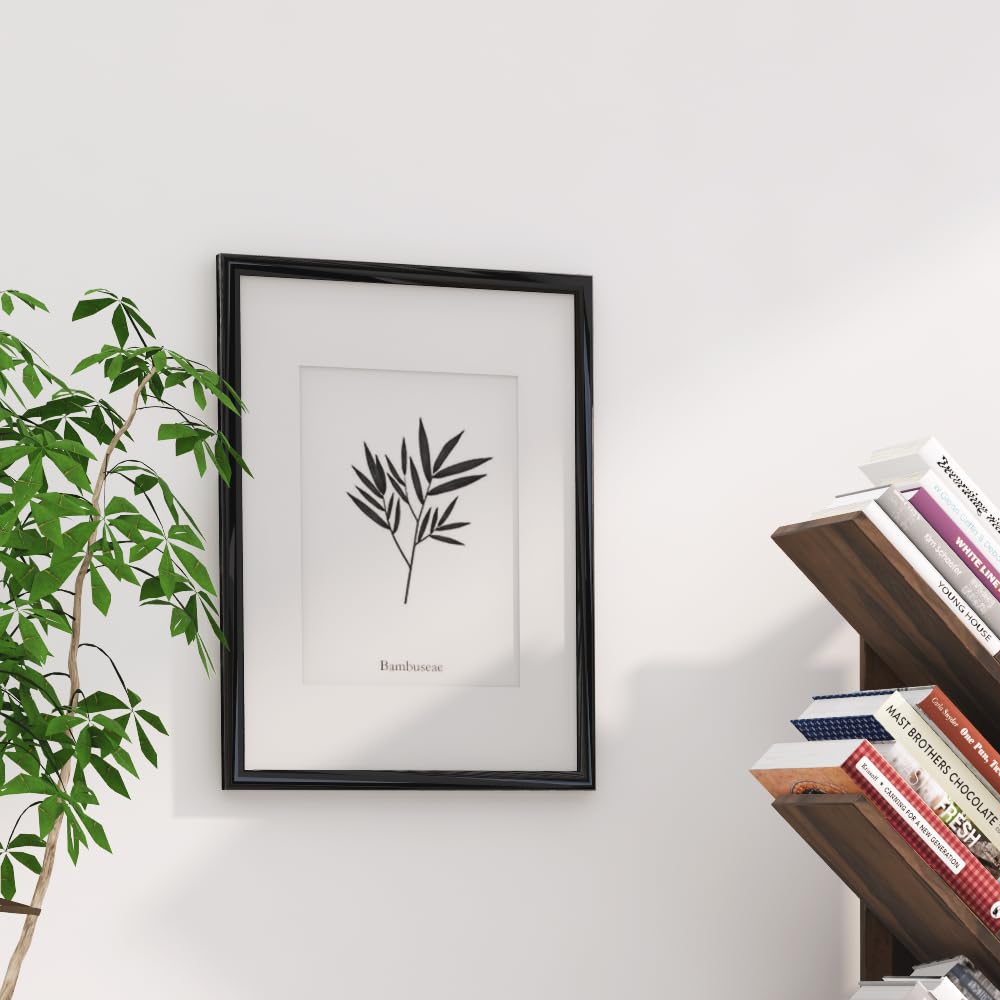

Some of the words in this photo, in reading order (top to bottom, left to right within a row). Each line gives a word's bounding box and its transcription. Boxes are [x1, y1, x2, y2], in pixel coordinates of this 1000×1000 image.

[955, 536, 984, 568] WHITE
[980, 563, 1000, 590] LINE
[937, 580, 965, 613] YOUNG
[964, 611, 992, 642] HOUSE
[380, 659, 443, 672] Bambuseae
[931, 697, 944, 712] Carla
[943, 708, 959, 728] Snyder
[959, 727, 975, 744] One
[973, 741, 989, 764] Pan,
[886, 704, 911, 733] MAST
[908, 727, 952, 775] BROTHERS
[949, 772, 999, 826] CHOCOLATE
[884, 787, 907, 812] CANNING
[905, 809, 918, 822] FOR
[919, 823, 933, 838] NEW
[930, 836, 961, 869] GENERATION
[940, 794, 981, 848] FRESH
